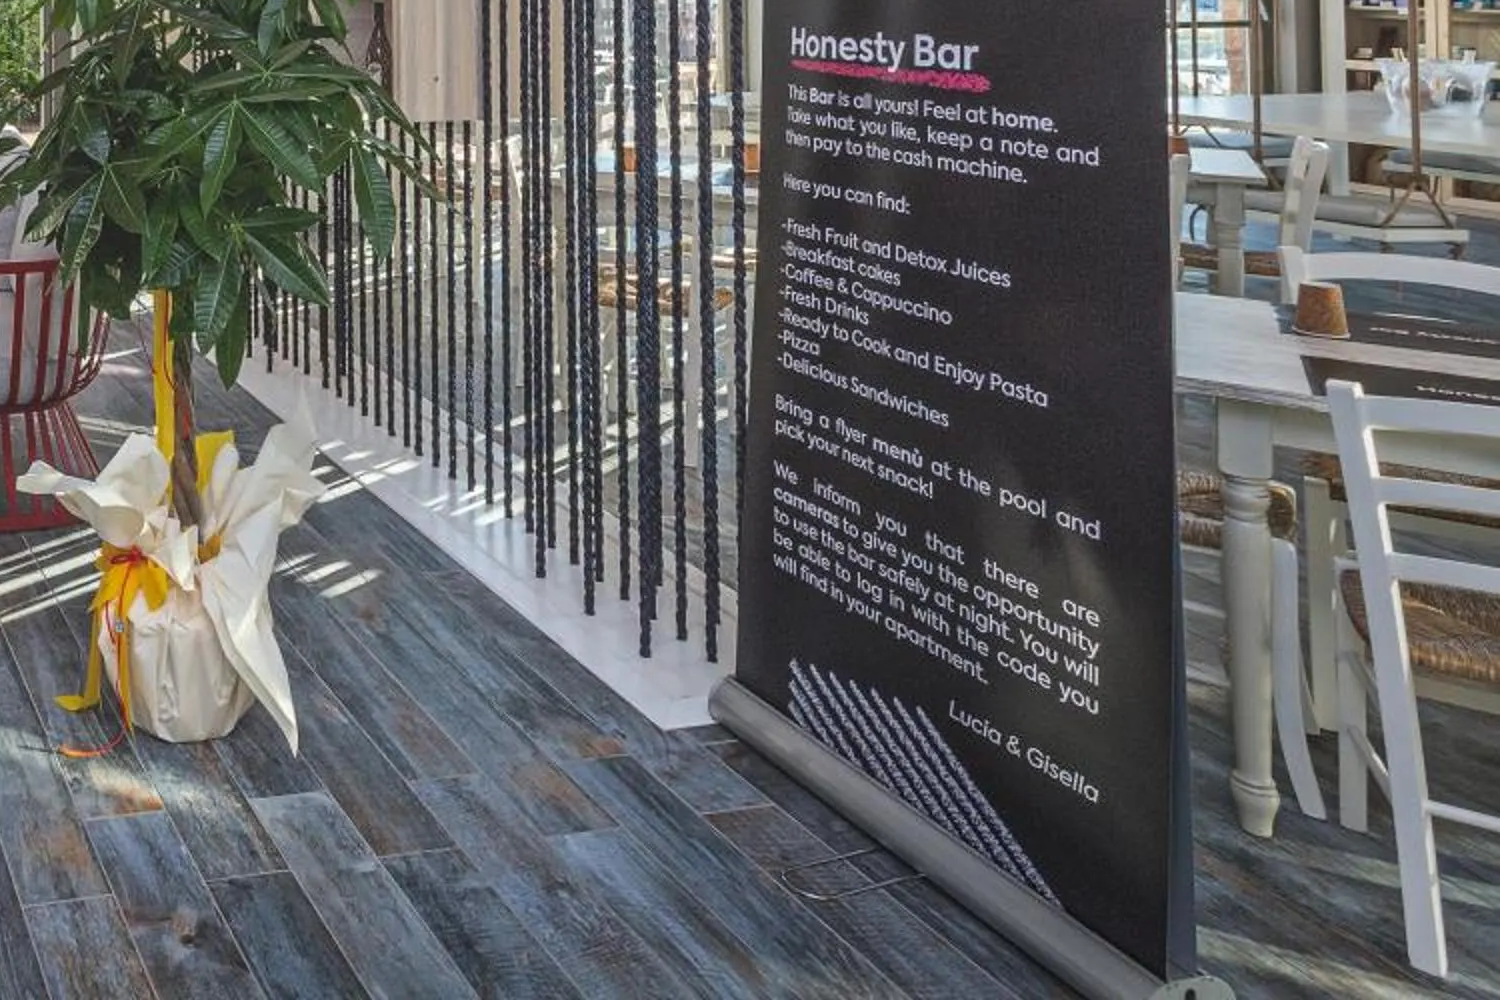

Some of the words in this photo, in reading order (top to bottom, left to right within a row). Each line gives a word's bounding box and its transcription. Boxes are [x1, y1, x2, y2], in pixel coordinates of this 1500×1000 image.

[791, 27, 905, 72] Honesty
[914, 34, 979, 71] Bar
[788, 84, 807, 101] This
[810, 88, 835, 105] Bar
[839, 90, 849, 108] is
[853, 92, 872, 110] all
[875, 95, 919, 116] yours!
[924, 100, 960, 121] Feel
[966, 107, 987, 124] at
[992, 108, 1058, 133] home.
[788, 106, 811, 124] Take
[815, 112, 854, 130] what
[859, 119, 887, 137] you
[891, 121, 920, 144] like,
[927, 127, 972, 151] keep
[980, 137, 993, 151] a
[1000, 138, 1048, 159] note
[1056, 145, 1098, 166] and
[785, 129, 811, 147] then
[813, 136, 841, 156] pay
[845, 139, 863, 156] to
[866, 143, 889, 161] the
[894, 147, 932, 168] cash
[938, 156, 1027, 183] machine.
[784, 174, 811, 193] Here
[813, 183, 840, 200] you
[845, 188, 873, 204] can
[877, 191, 910, 215] find:
[825, 225, 859, 248] Fruit
[862, 235, 890, 258] and
[896, 244, 947, 272] Detox
[950, 258, 1011, 288] Juices
[857, 261, 900, 285] cakes
[825, 298, 869, 325] Drinks
[837, 278, 848, 294] &
[852, 281, 952, 325] Cappuccino
[833, 325, 849, 342] to
[852, 331, 891, 357] Cook
[894, 346, 929, 370] and
[935, 356, 985, 390] Enjoy
[990, 372, 1048, 408] Pasta
[852, 375, 948, 427] Sandwiches
[775, 419, 804, 442] pick
[807, 435, 839, 457] your
[842, 447, 875, 475] next
[877, 461, 933, 498] snack!
[775, 394, 812, 425] Bring
[820, 414, 829, 429] a
[835, 417, 866, 445] flyer
[931, 458, 953, 480] at
[959, 468, 991, 497] the
[1000, 487, 1046, 518] pool
[1056, 508, 1100, 540] and
[774, 460, 798, 485] We
[813, 478, 860, 515] inform
[875, 512, 907, 537] you
[925, 530, 965, 565] that
[983, 558, 1039, 598] there
[1063, 598, 1100, 628] are
[774, 487, 839, 530] cameras
[843, 520, 858, 538] to
[862, 529, 897, 558] give
[901, 550, 933, 574] you
[938, 562, 969, 593] the
[974, 587, 1100, 659] opportunity
[773, 553, 796, 575] will
[800, 566, 828, 594] find
[831, 584, 843, 603] in
[846, 594, 881, 623] your
[884, 616, 988, 685] apartment.
[774, 507, 789, 526] to
[793, 517, 819, 539] use
[821, 529, 844, 555] the
[848, 543, 875, 569] bar
[879, 562, 930, 600] safely
[934, 589, 955, 613] at
[959, 601, 1014, 642] night.
[1020, 630, 1058, 665] You
[1063, 652, 1099, 685] will
[774, 528, 792, 551] be
[799, 542, 830, 571] able
[835, 561, 851, 581] to
[857, 570, 882, 597] log
[890, 588, 904, 612] in
[911, 602, 949, 636] with
[957, 623, 989, 655] the
[997, 650, 1051, 688] code
[1059, 681, 1098, 714] you
[949, 699, 1001, 745] Lucia
[1007, 735, 1021, 757] &
[1027, 747, 1098, 803] Gisella
